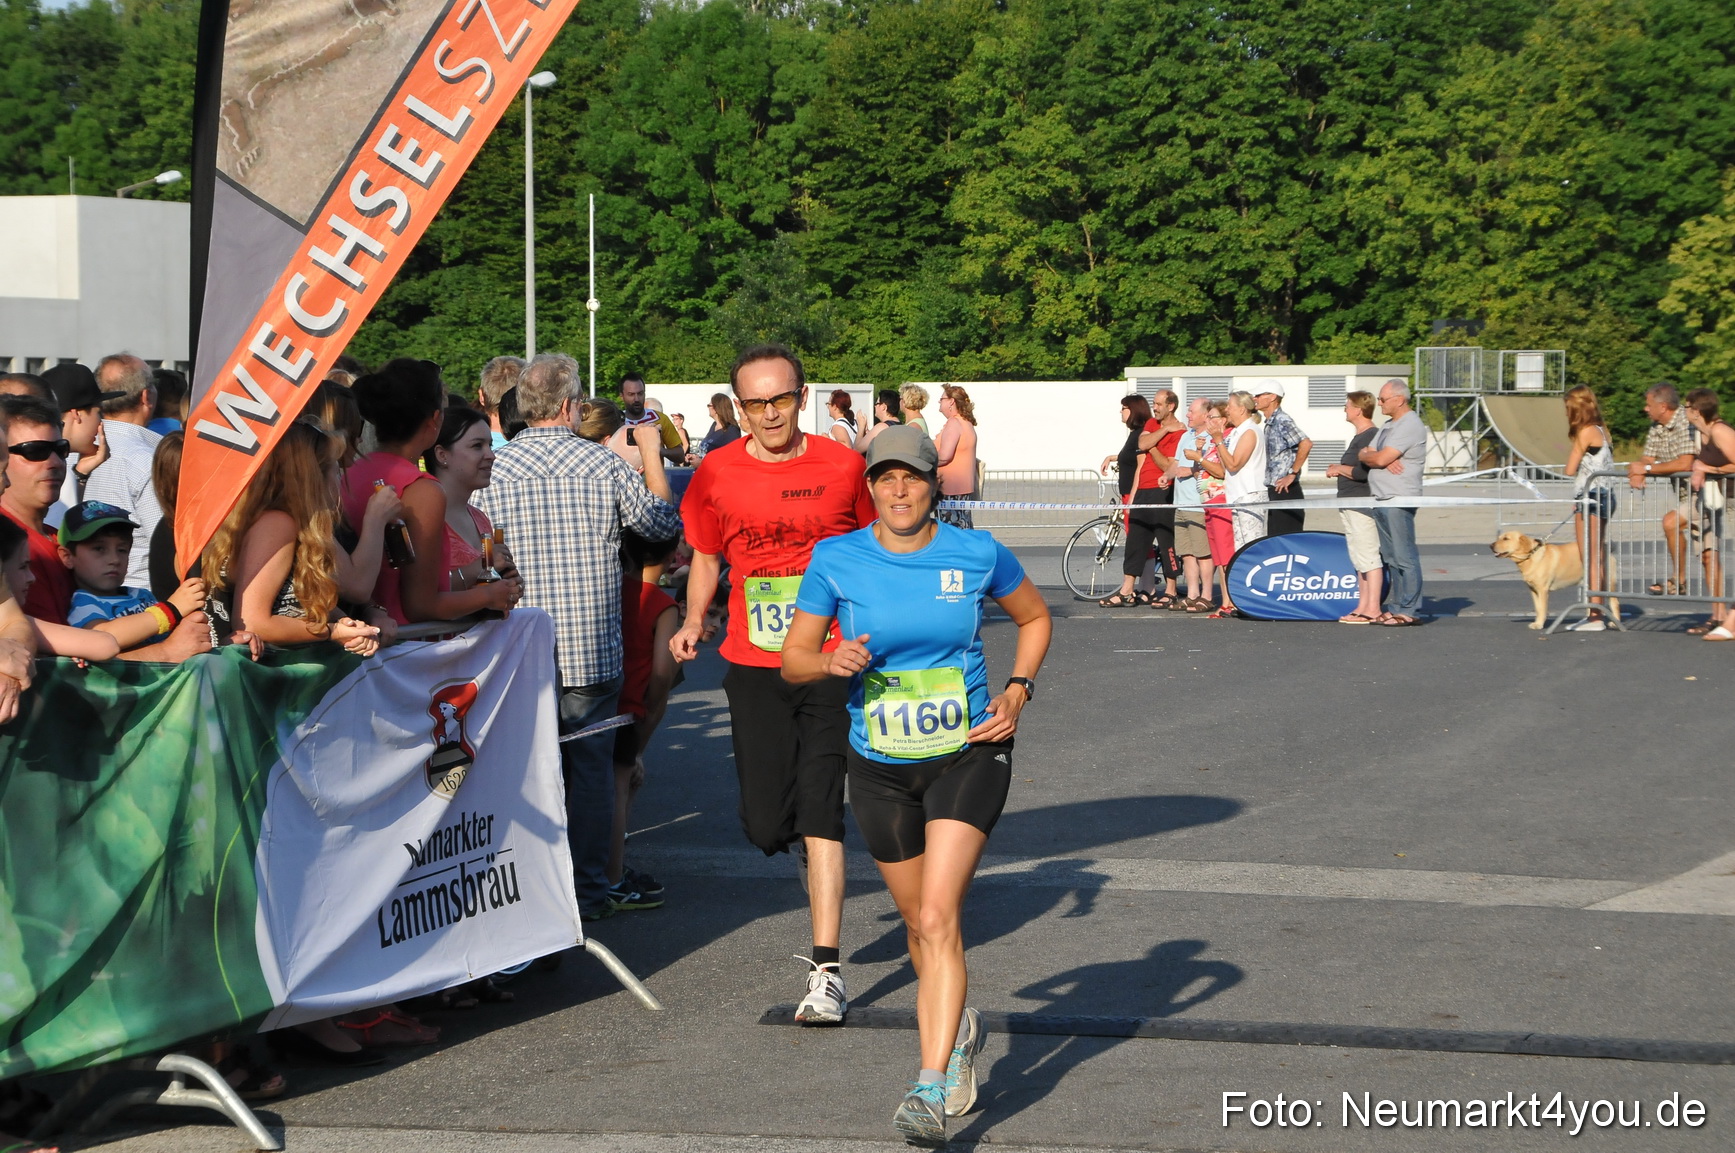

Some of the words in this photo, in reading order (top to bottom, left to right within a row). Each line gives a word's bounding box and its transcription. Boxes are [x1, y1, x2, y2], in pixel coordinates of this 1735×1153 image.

[193, 0, 551, 456] WECHSELSZ
[781, 488, 812, 499] swn
[1267, 570, 1360, 592] Fische
[1276, 592, 1360, 602] AUTOMOBILE
[869, 699, 963, 737] 1160
[376, 852, 522, 949] Lammsbräu
